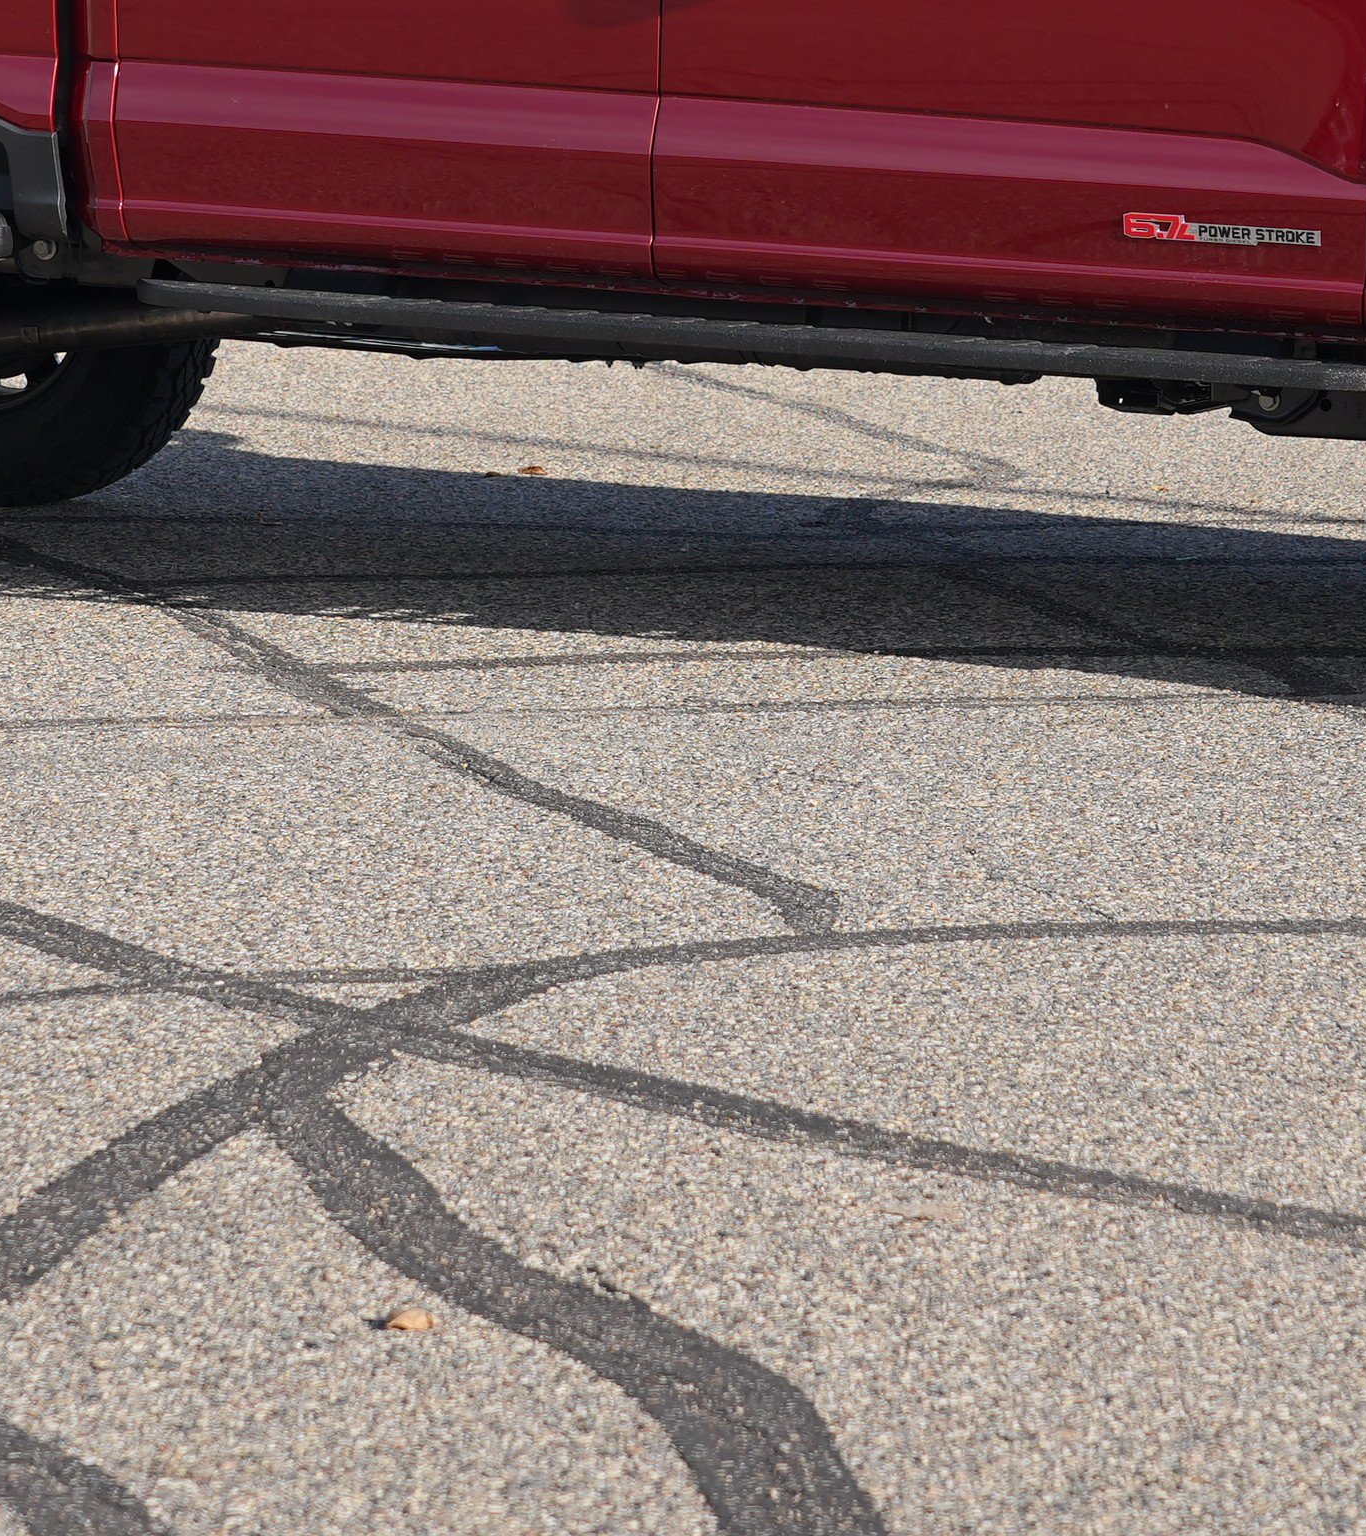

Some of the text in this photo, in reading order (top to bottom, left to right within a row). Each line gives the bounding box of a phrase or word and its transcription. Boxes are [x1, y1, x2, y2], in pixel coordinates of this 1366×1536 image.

[1123, 212, 1316, 244] 6.7L POWER STROKE
